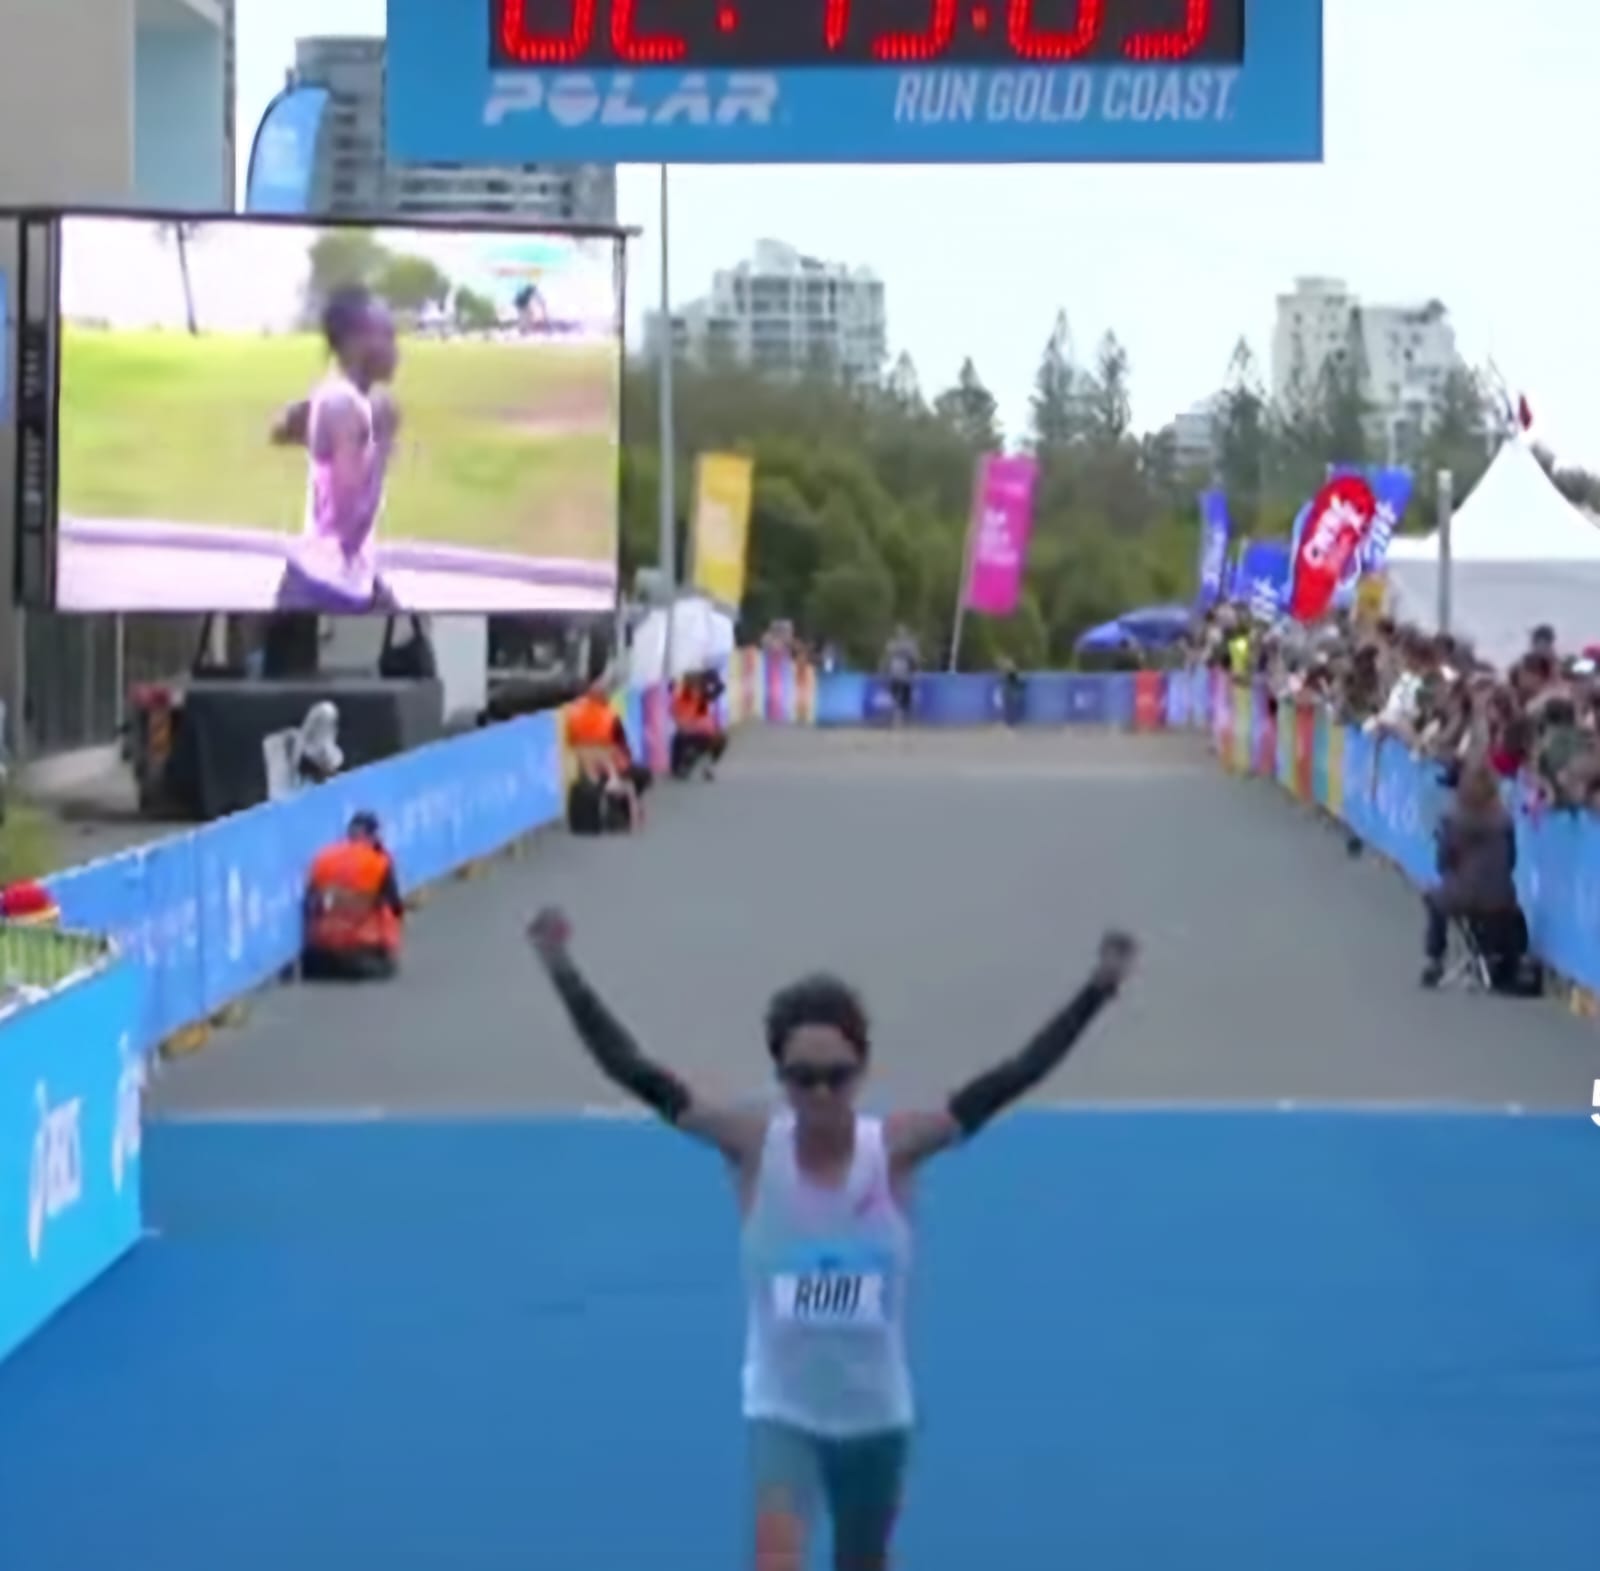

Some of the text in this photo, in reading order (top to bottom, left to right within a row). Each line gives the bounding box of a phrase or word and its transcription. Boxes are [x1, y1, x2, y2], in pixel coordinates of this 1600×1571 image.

[482, 70, 779, 127] POLAR
[893, 67, 1236, 122] RUN GOLD COAST
